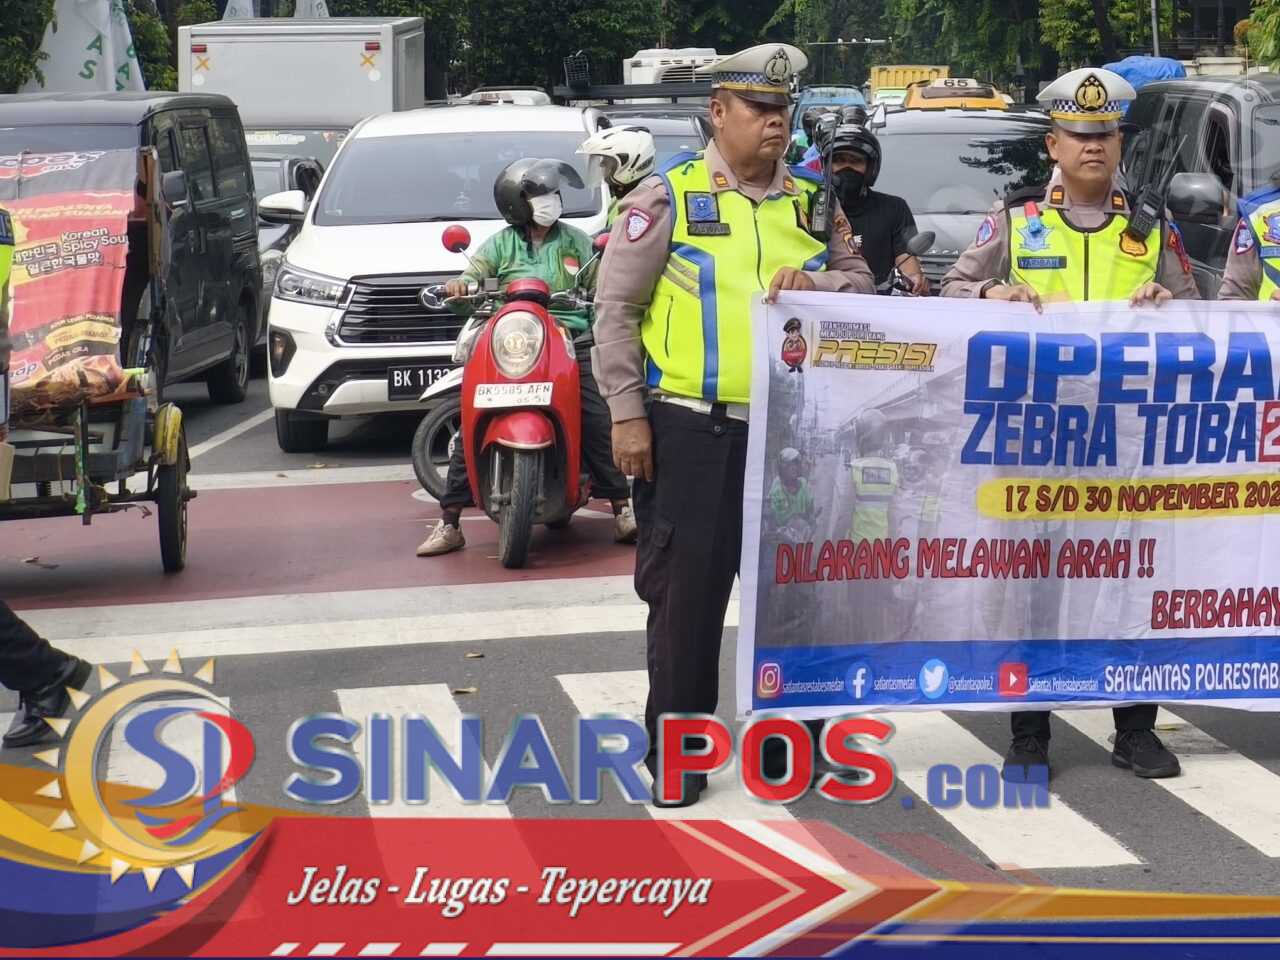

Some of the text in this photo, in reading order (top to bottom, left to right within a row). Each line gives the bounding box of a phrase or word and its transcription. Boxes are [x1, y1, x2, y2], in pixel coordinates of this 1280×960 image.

[943, 79, 968, 87] 65
[61, 227, 108, 242] Korean
[62, 238, 98, 254] Spicy
[816, 340, 937, 366] PRESISI
[394, 370, 412, 387] BK
[960, 401, 1118, 466] ZEBRA
[1137, 401, 1257, 464] TOBA
[1005, 485, 1028, 512] 17
[1035, 485, 1079, 512] S/D
[1084, 486, 1112, 512] 30
[1117, 483, 1239, 512] NOPEMBER
[775, 538, 911, 584] DILARANG
[916, 538, 1051, 580] MELAWAN
[1056, 538, 1131, 580] ARAH
[1104, 662, 1190, 692] SATLANTAS
